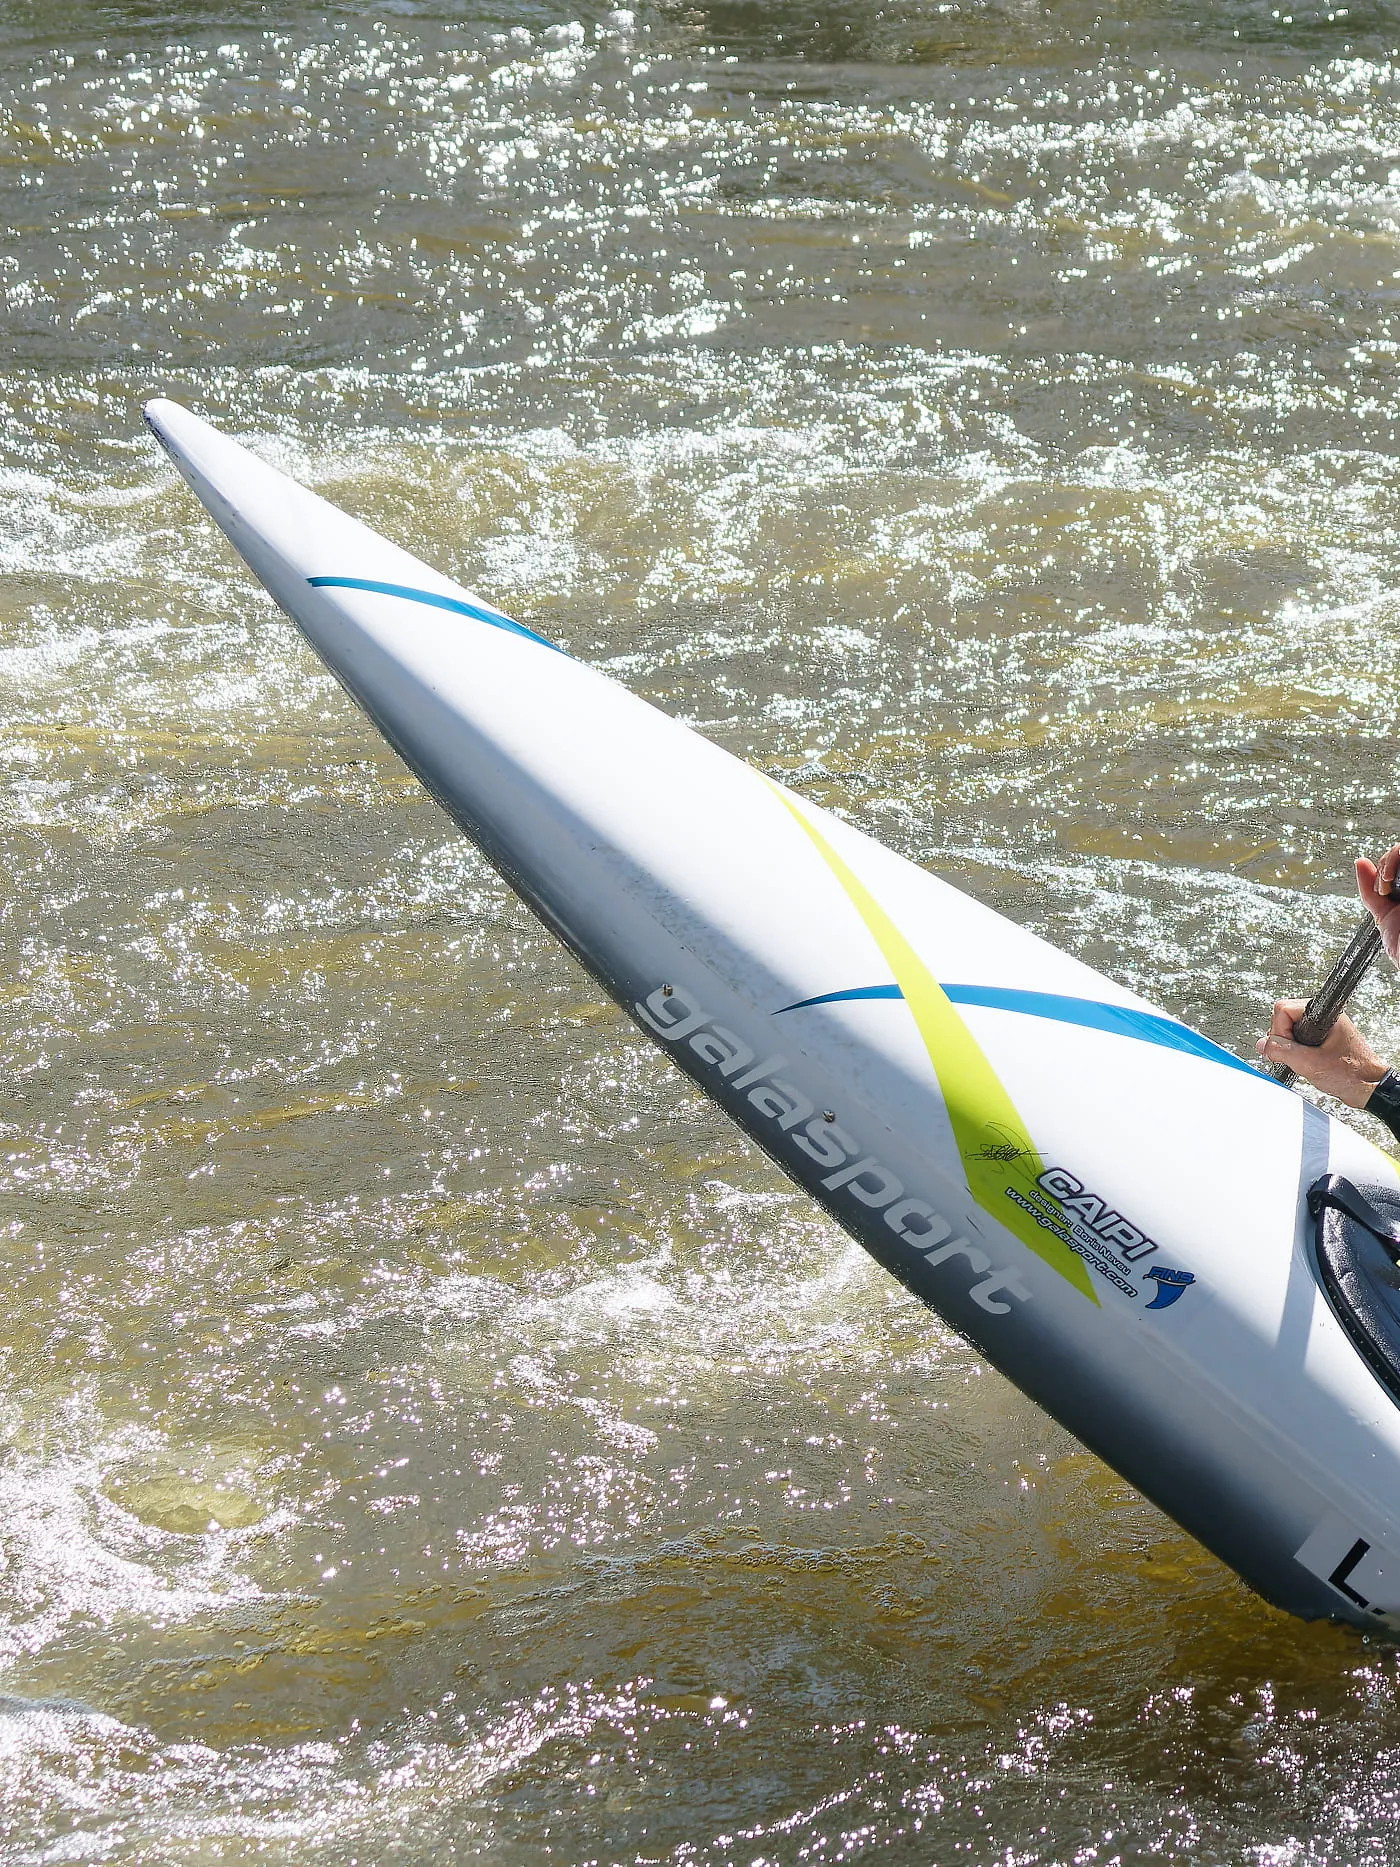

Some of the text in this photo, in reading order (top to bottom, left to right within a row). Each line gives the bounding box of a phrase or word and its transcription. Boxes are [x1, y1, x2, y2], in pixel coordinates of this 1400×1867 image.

[634, 984, 1033, 1315] galasport
[1005, 1187, 1138, 1297] www.galasport.com
[1036, 1167, 1158, 1262] CAIPI
[1149, 1266, 1194, 1284] FINS
